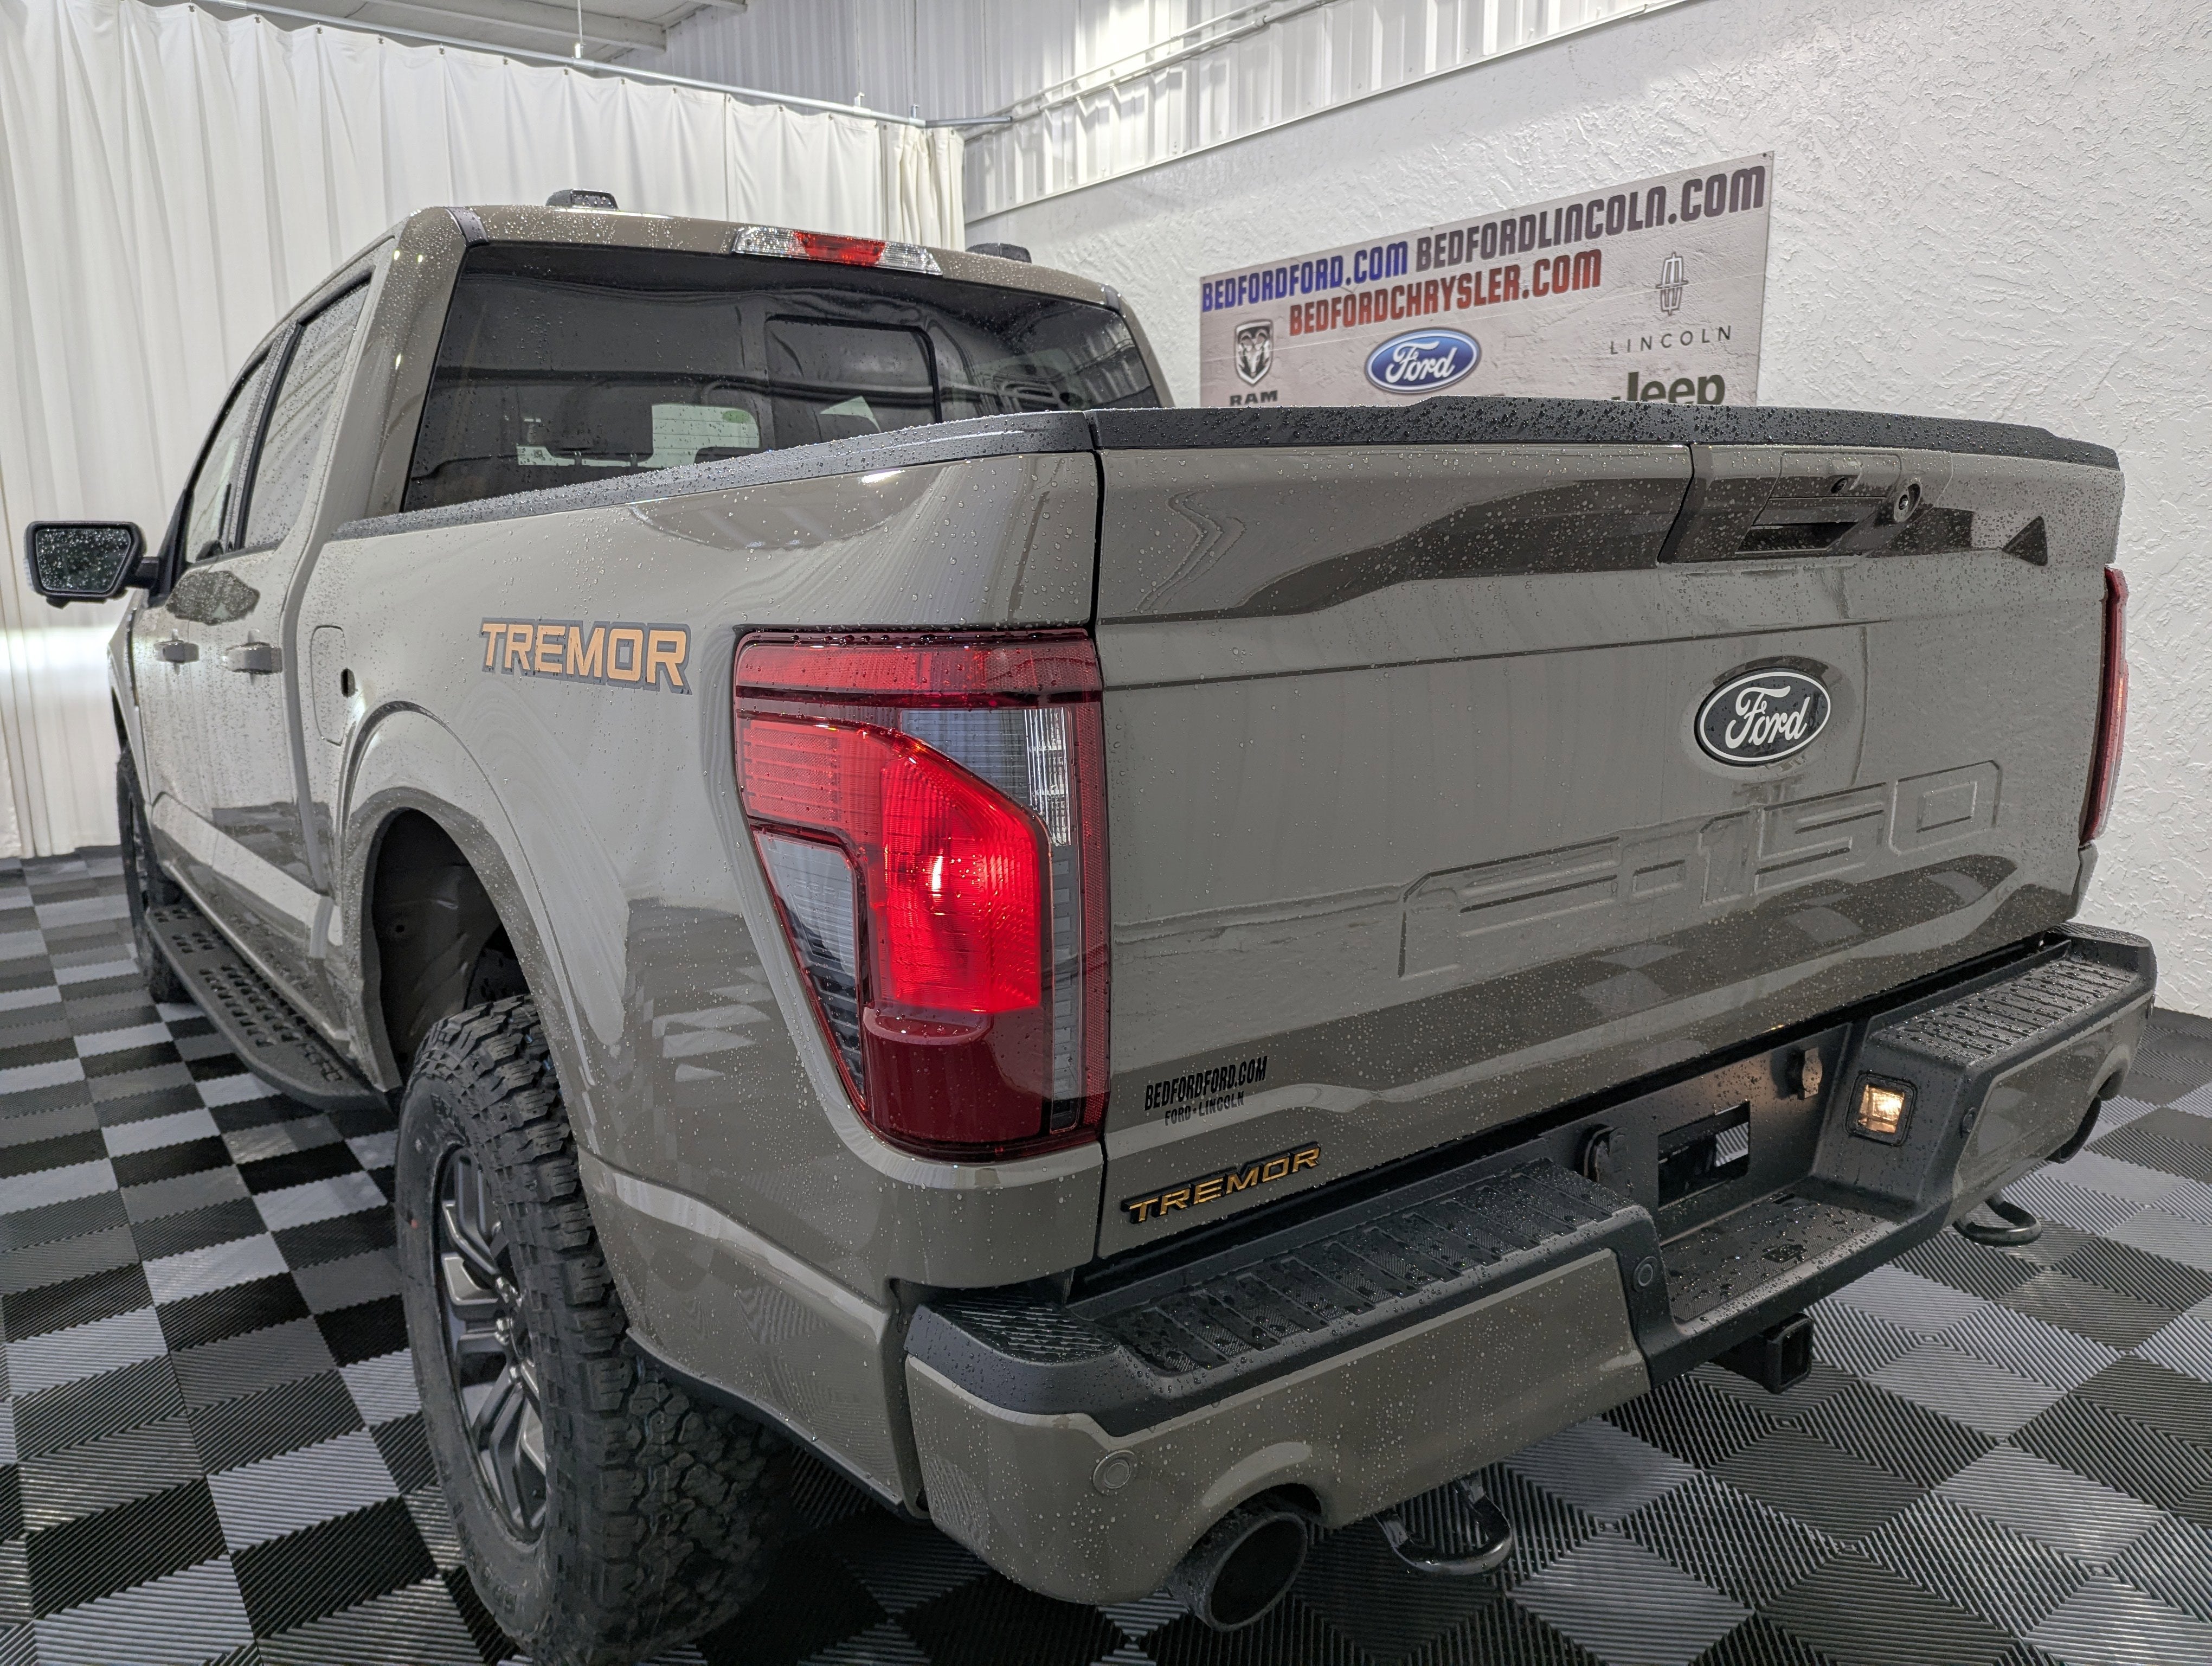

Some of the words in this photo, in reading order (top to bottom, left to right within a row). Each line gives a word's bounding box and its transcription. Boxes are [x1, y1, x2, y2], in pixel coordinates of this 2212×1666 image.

[1202, 241, 1408, 312] BEDFORDFORD.COM
[1416, 165, 1765, 272] BEDFORDLINCOLN.COM
[1289, 249, 1602, 336] BEDFORDCHRYSLER.COM
[1385, 341, 1458, 383] Ford
[1610, 326, 1731, 355] LINCOLN
[1230, 390, 1278, 407] RAM
[480, 618, 692, 695] TREMOR
[1725, 685, 1811, 749] Ford
[1144, 1055, 1268, 1111] BEDFORDFORD.COM
[1120, 1141, 1321, 1225] TREMOR
